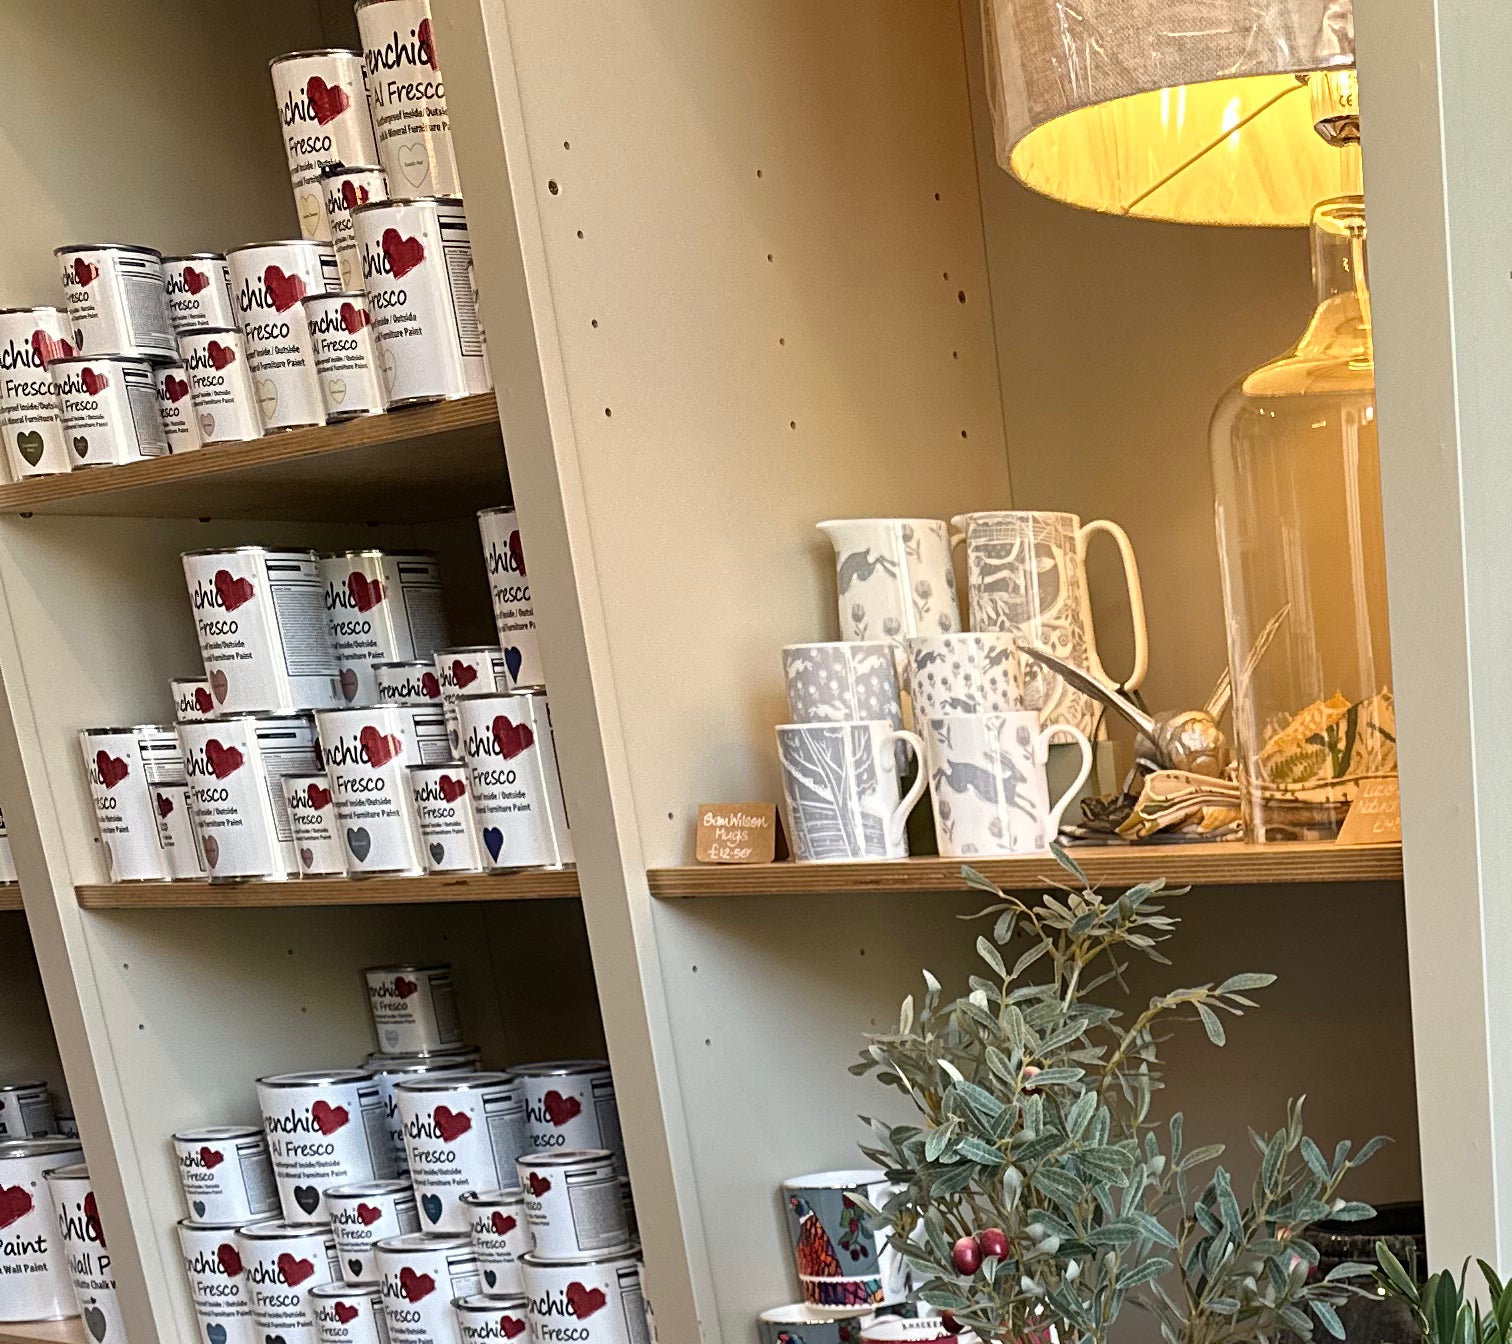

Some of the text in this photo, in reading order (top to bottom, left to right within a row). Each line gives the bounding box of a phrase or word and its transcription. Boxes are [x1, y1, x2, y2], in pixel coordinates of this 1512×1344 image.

[388, 81, 445, 105] Fresco
[289, 136, 331, 157] Fresco
[331, 219, 352, 233] Fresc
[363, 241, 391, 280] chic
[166, 273, 188, 295] chic
[239, 277, 274, 312] chic
[170, 299, 199, 312] Fresco
[245, 323, 289, 344] Fresco
[322, 339, 357, 352] Fresco
[6, 379, 55, 398] Fresco
[56, 373, 87, 396] nchic
[192, 375, 224, 387] Fresco
[65, 399, 98, 412] Fresco
[161, 407, 180, 418] esco
[194, 578, 224, 610] chic
[324, 581, 357, 611] chic
[199, 619, 238, 636] Fresco
[326, 736, 370, 766] nchic
[187, 747, 214, 777] chic
[337, 776, 385, 794] Fresco
[472, 767, 516, 788] Fresco
[415, 780, 445, 802] nchic
[293, 813, 323, 825] Fresco
[423, 807, 455, 819] Fresco
[715, 827, 749, 847] Mugs
[265, 1108, 322, 1136] enchic
[403, 1112, 442, 1140] nchic
[285, 1141, 335, 1158] Fresco
[530, 1133, 565, 1147] esco
[412, 1148, 455, 1165] Fresco
[59, 1203, 102, 1242] chic
[341, 1228, 372, 1239] Fresco
[0, 1234, 47, 1257] aint
[477, 1238, 506, 1250] Fresco
[25, 1262, 48, 1273] Paint
[186, 1251, 227, 1275] nchic
[246, 1260, 287, 1286] nchic
[197, 1281, 239, 1298] Fresco
[382, 1273, 407, 1299] chic
[256, 1292, 300, 1308] Fresco
[527, 1290, 575, 1317] nchic
[321, 1325, 348, 1337] Fresco
[542, 1325, 589, 1341] Fresco
